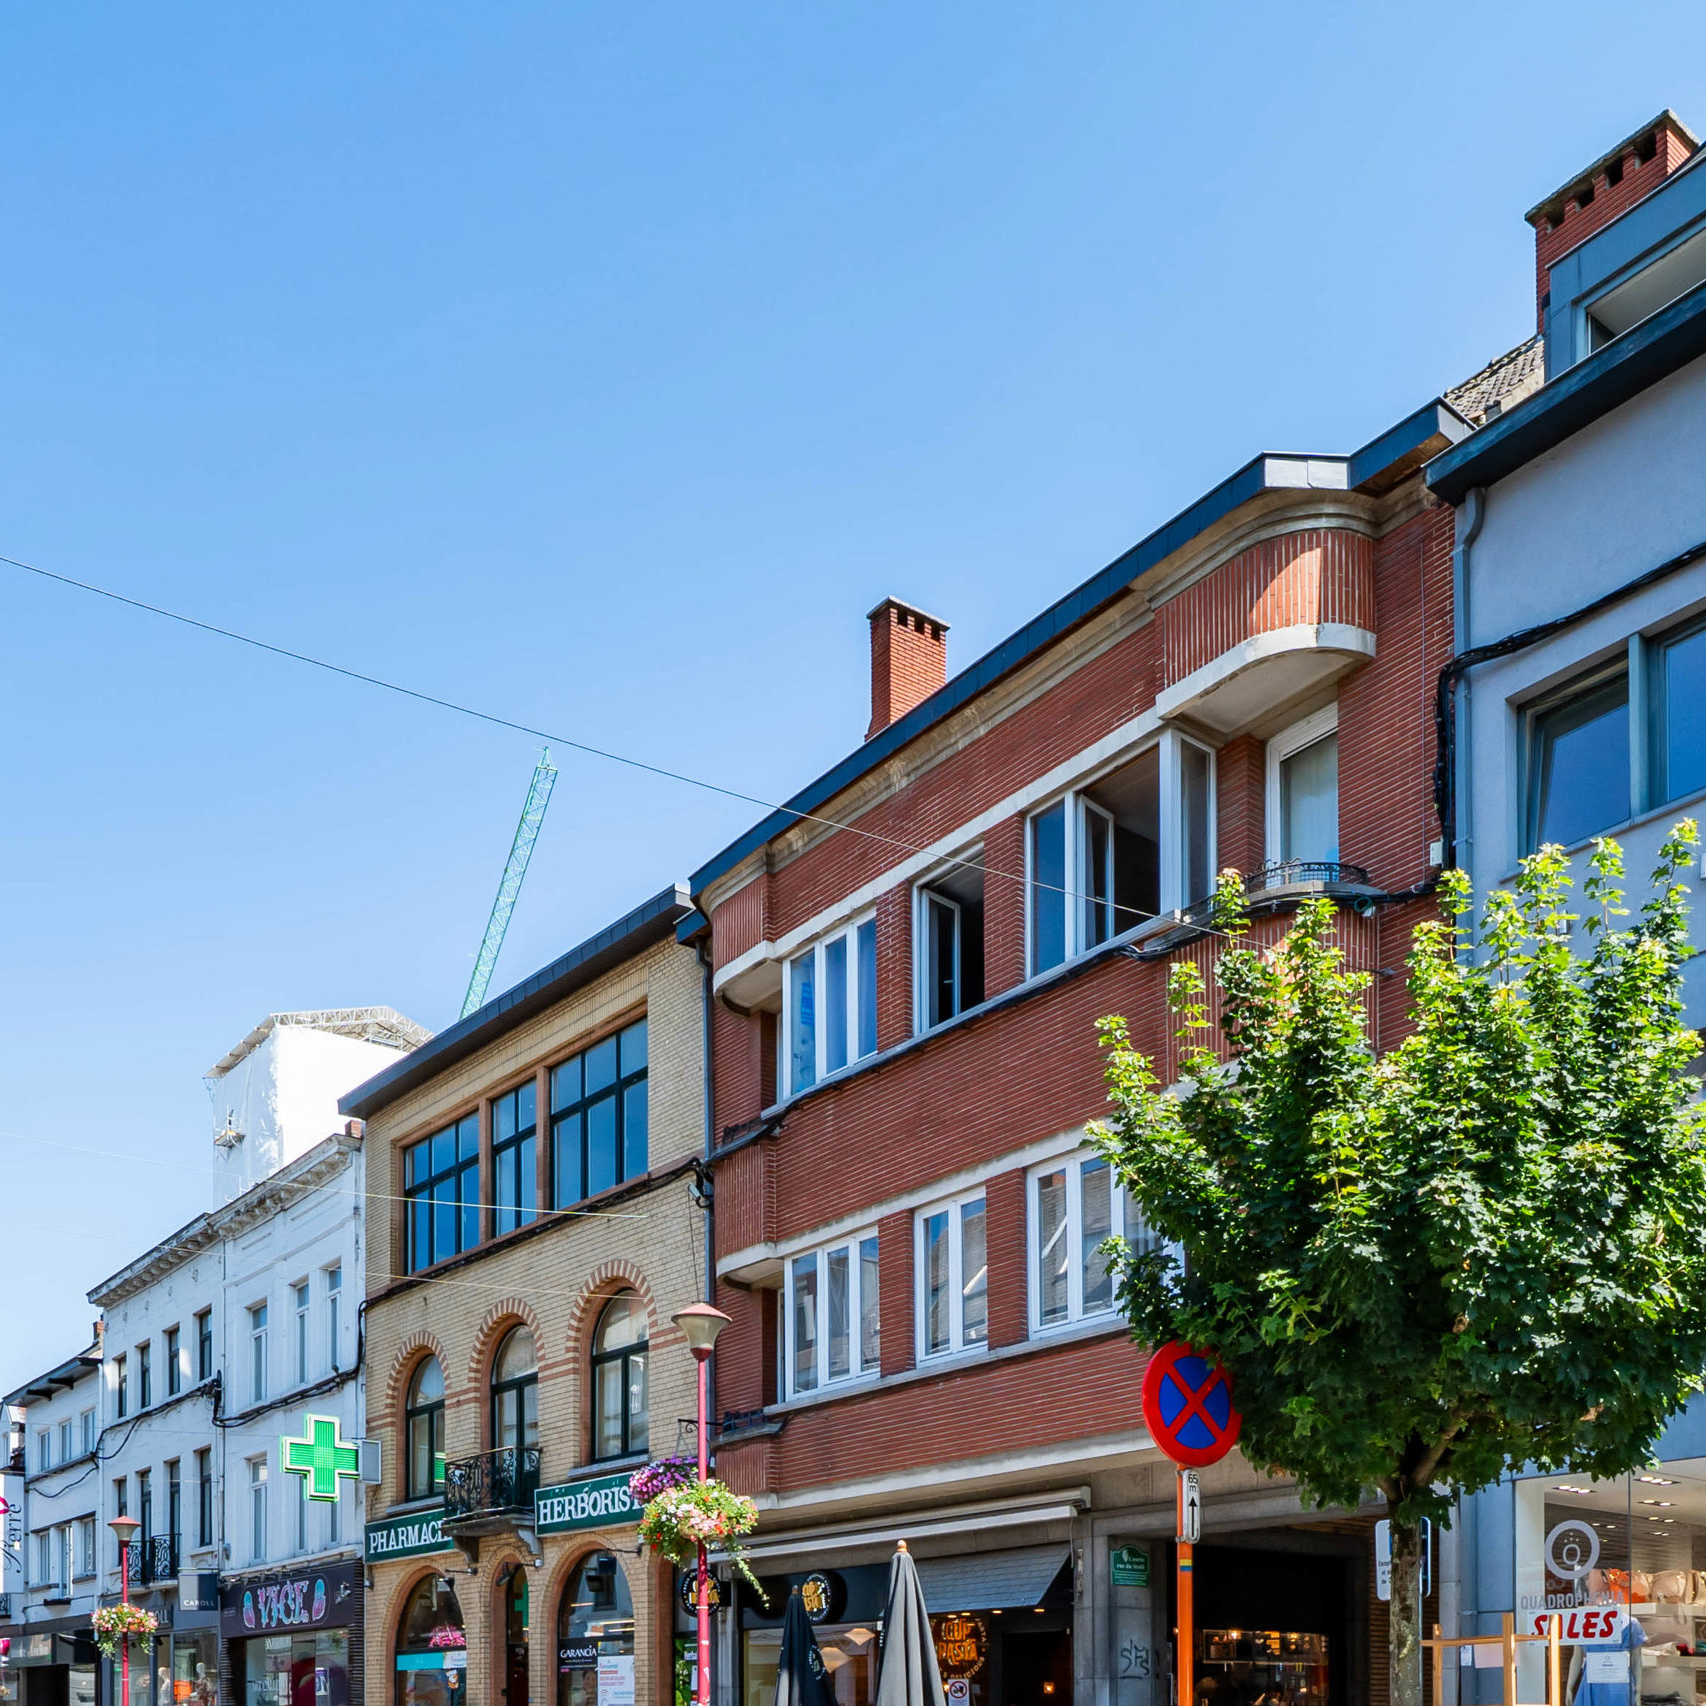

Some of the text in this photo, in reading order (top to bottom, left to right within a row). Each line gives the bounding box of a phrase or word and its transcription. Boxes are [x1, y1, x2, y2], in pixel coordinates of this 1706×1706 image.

[1187, 1473, 1199, 1485] 65
[1189, 1484, 1197, 1493] m
[183, 1599, 216, 1607] CAROLL
[257, 1580, 310, 1628] VICE
[1520, 1590, 1625, 1611] QUADROPHENIA
[944, 1618, 973, 1641] CUP
[560, 1644, 598, 1660] GARANCIA
[938, 1639, 979, 1666] PASTA
